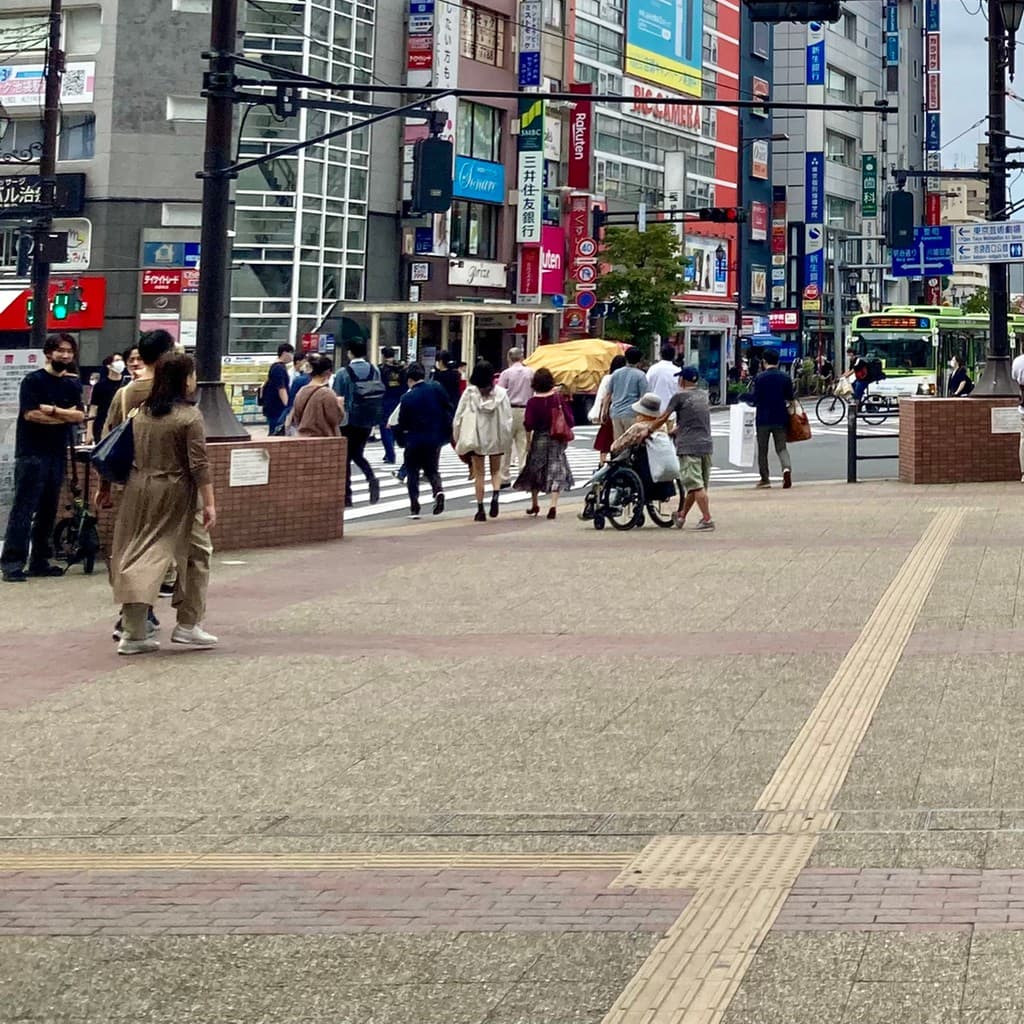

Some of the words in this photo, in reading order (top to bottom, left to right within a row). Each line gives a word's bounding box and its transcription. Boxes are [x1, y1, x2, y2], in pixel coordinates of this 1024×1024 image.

[655, 88, 701, 129] CAMERA
[574, 112, 586, 160] Rakuten
[521, 156, 538, 238] 三井住友銀行
[863, 177, 876, 204] 歯科
